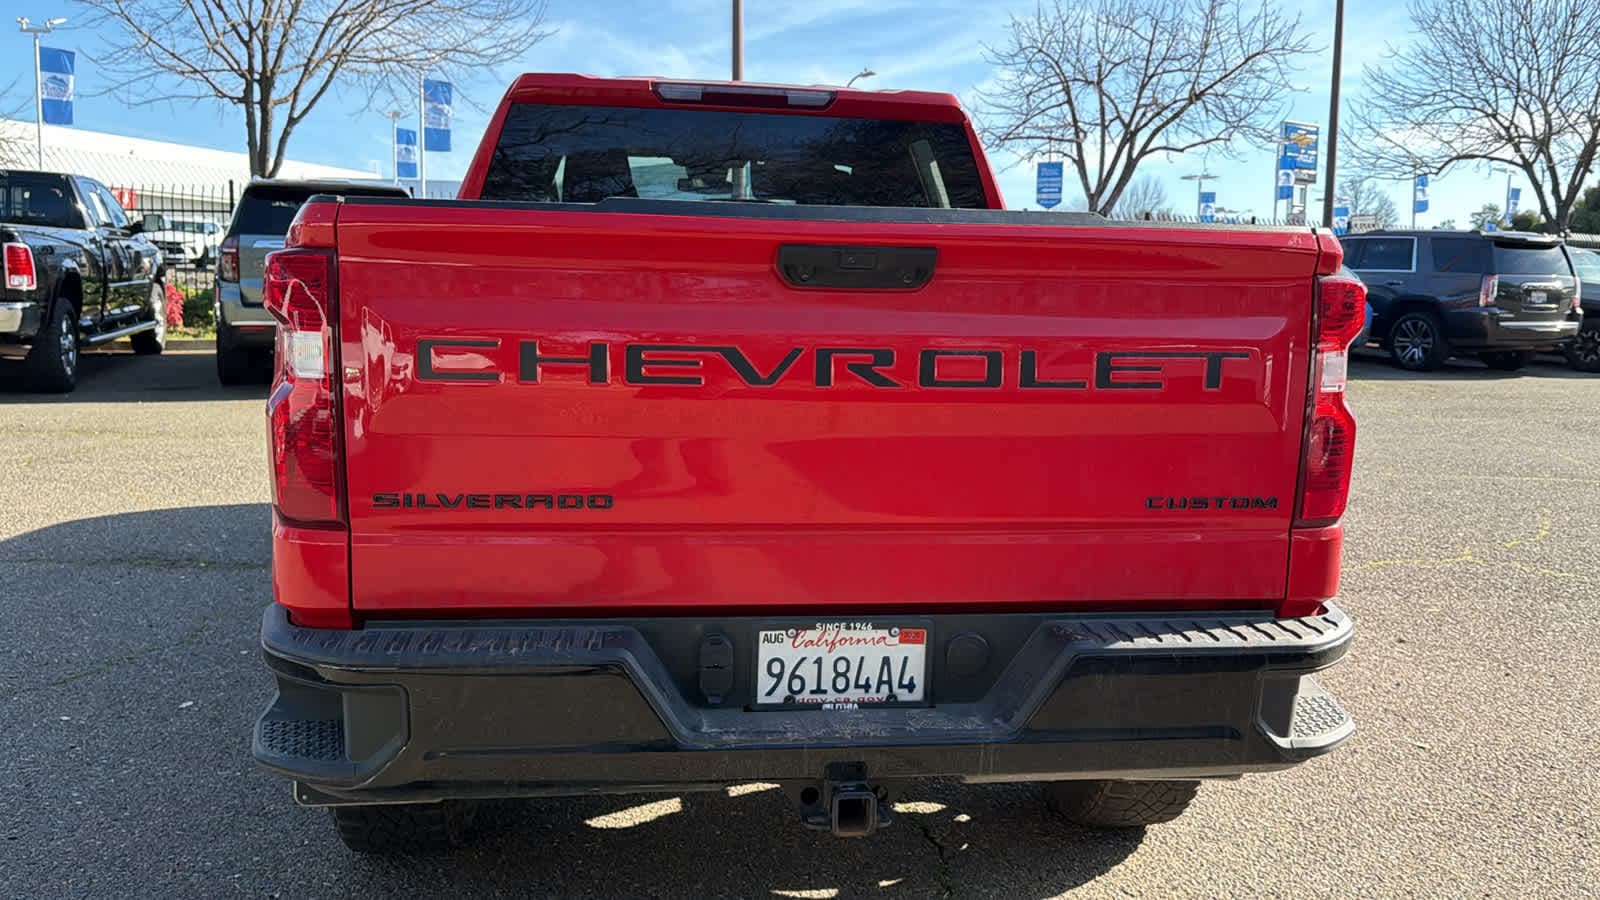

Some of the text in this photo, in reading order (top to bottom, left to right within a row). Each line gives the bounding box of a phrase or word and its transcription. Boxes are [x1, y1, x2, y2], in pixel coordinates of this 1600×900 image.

[417, 339, 1250, 390] CHEVROLET
[372, 493, 613, 509] SILVERADO
[1145, 497, 1278, 509] CUSTOM
[816, 623, 873, 631] SINCE 1946
[762, 633, 784, 643] AUG
[791, 630, 899, 653] California
[765, 656, 916, 696] 96184A4
